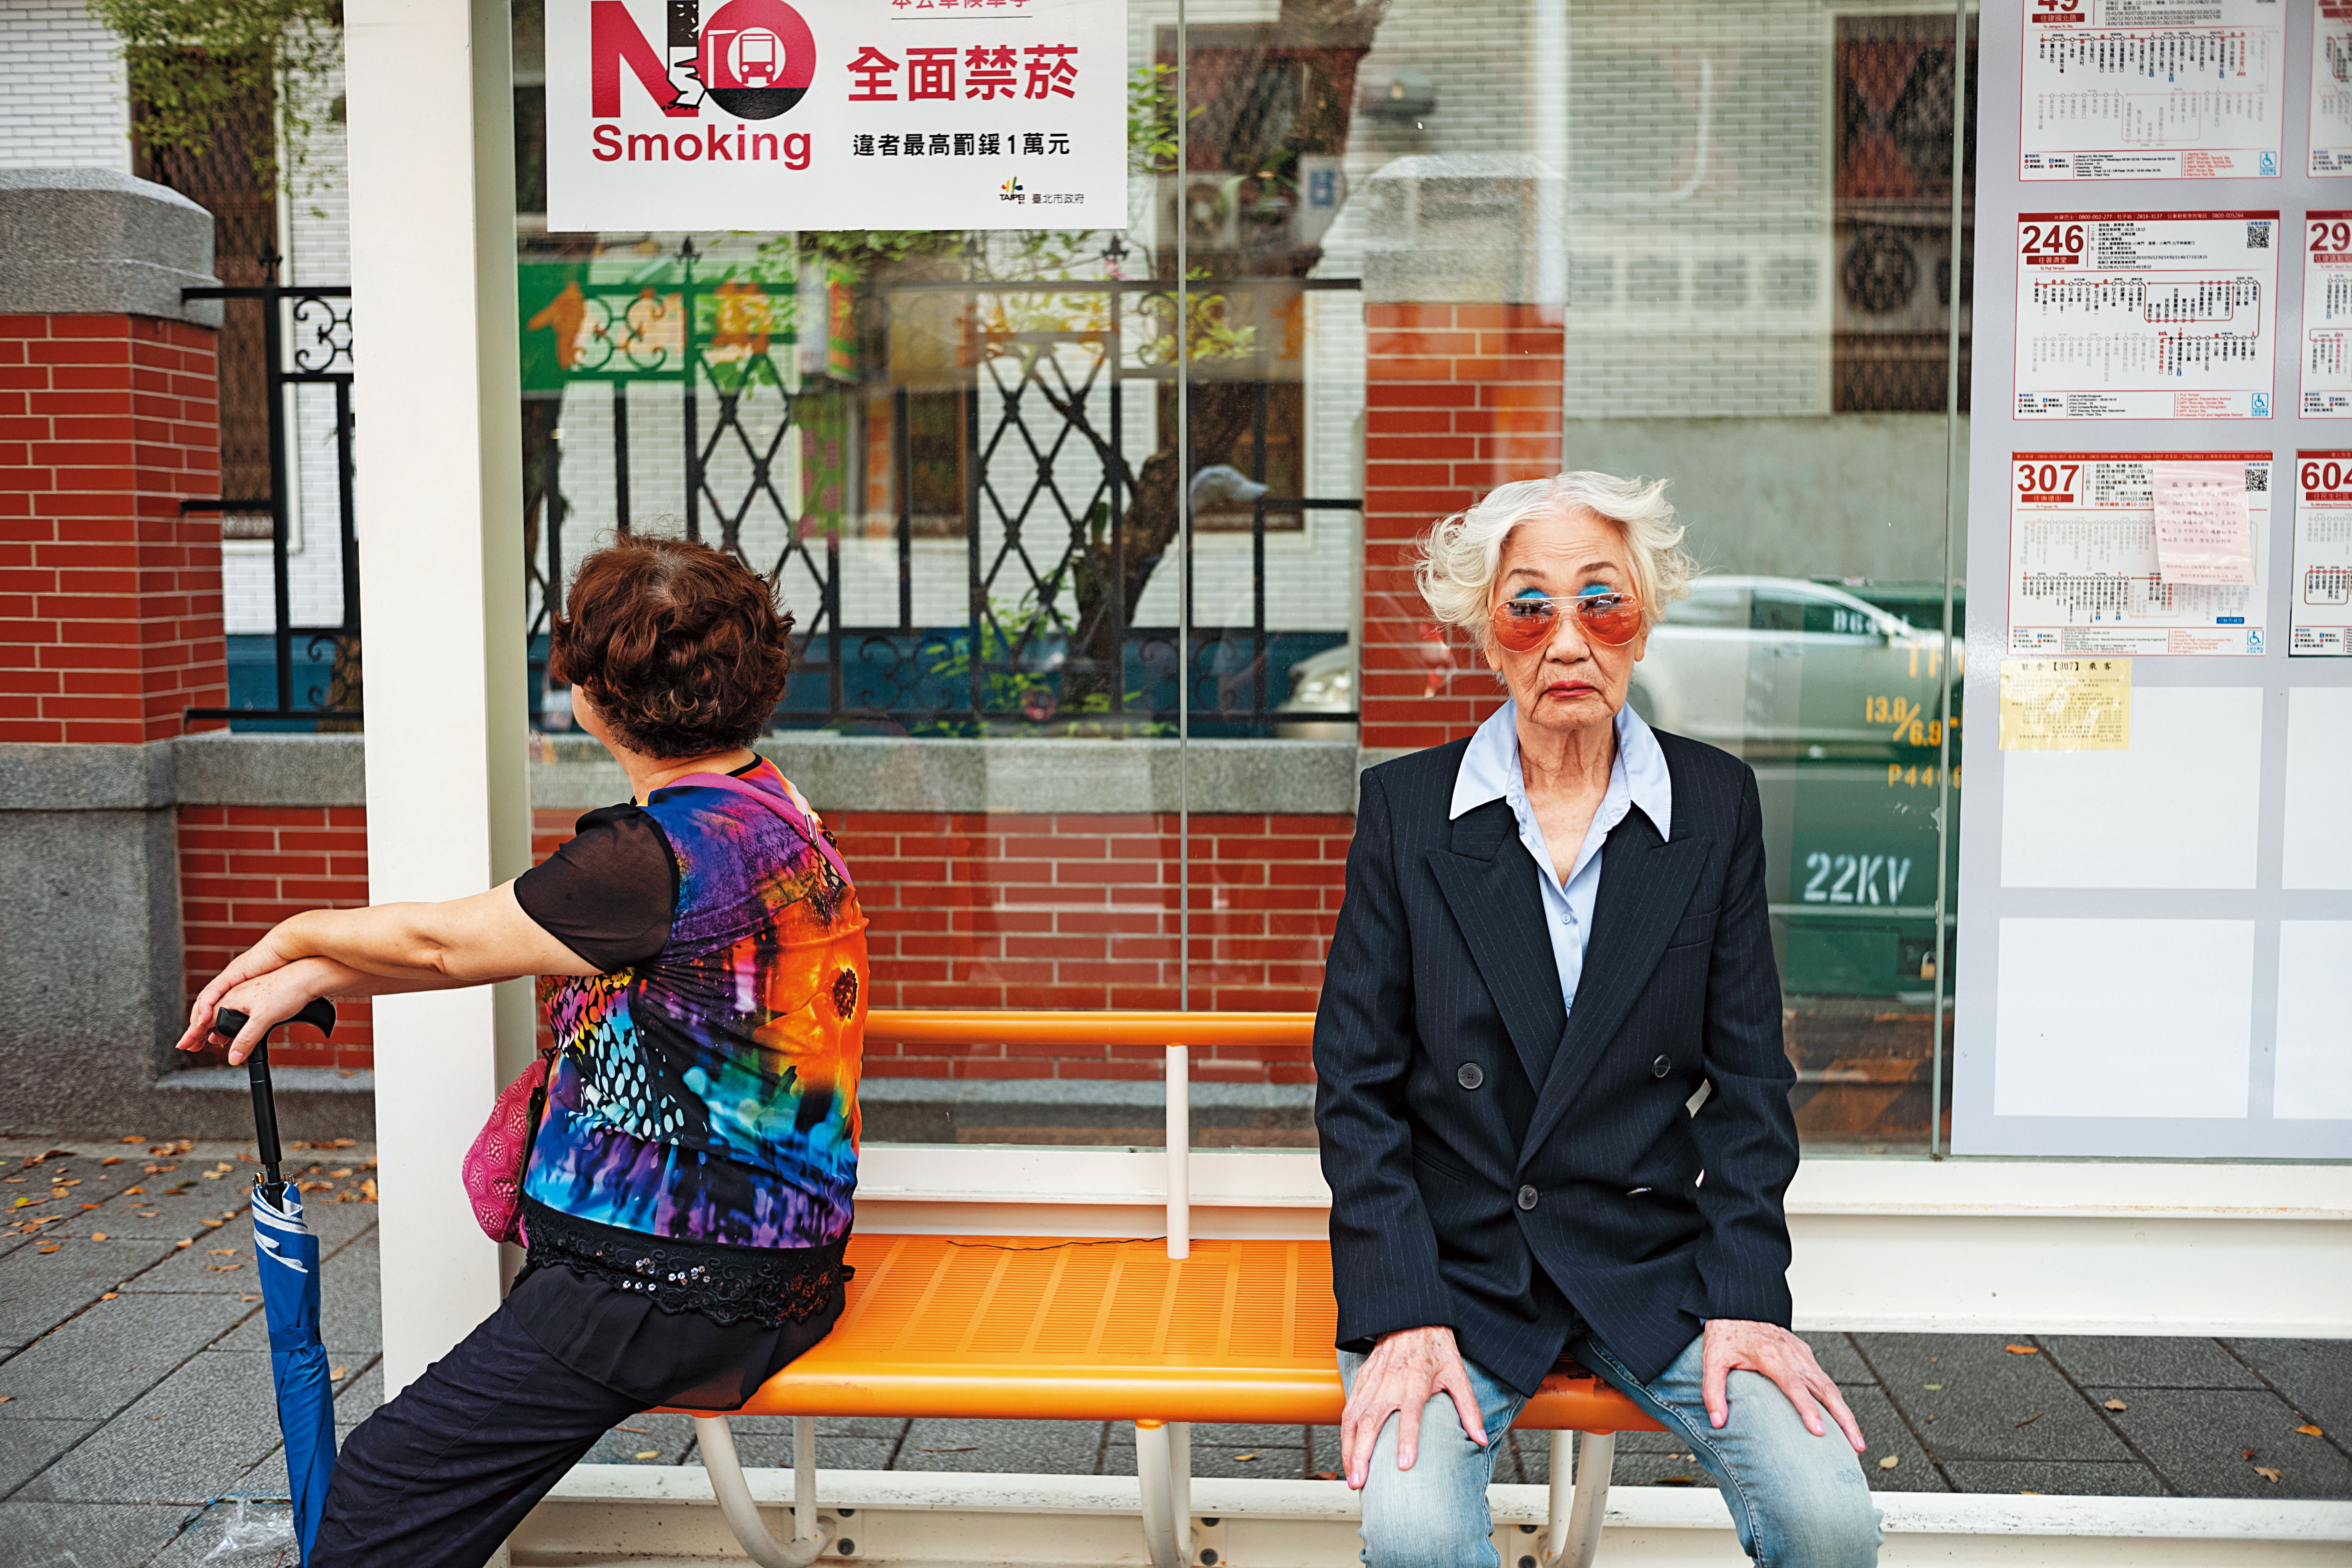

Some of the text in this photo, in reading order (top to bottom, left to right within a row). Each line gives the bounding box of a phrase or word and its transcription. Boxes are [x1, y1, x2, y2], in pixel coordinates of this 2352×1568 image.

[2040, 14, 2076, 22] 往建國北路
[847, 44, 1078, 102] 全面禁菸
[592, 124, 811, 170] Smoking
[1032, 194, 1084, 204] 臺北市政府
[2022, 225, 2084, 253] 246
[2310, 222, 2351, 251] 29
[2018, 464, 2079, 492] 307
[1804, 852, 1912, 906] 22KV
